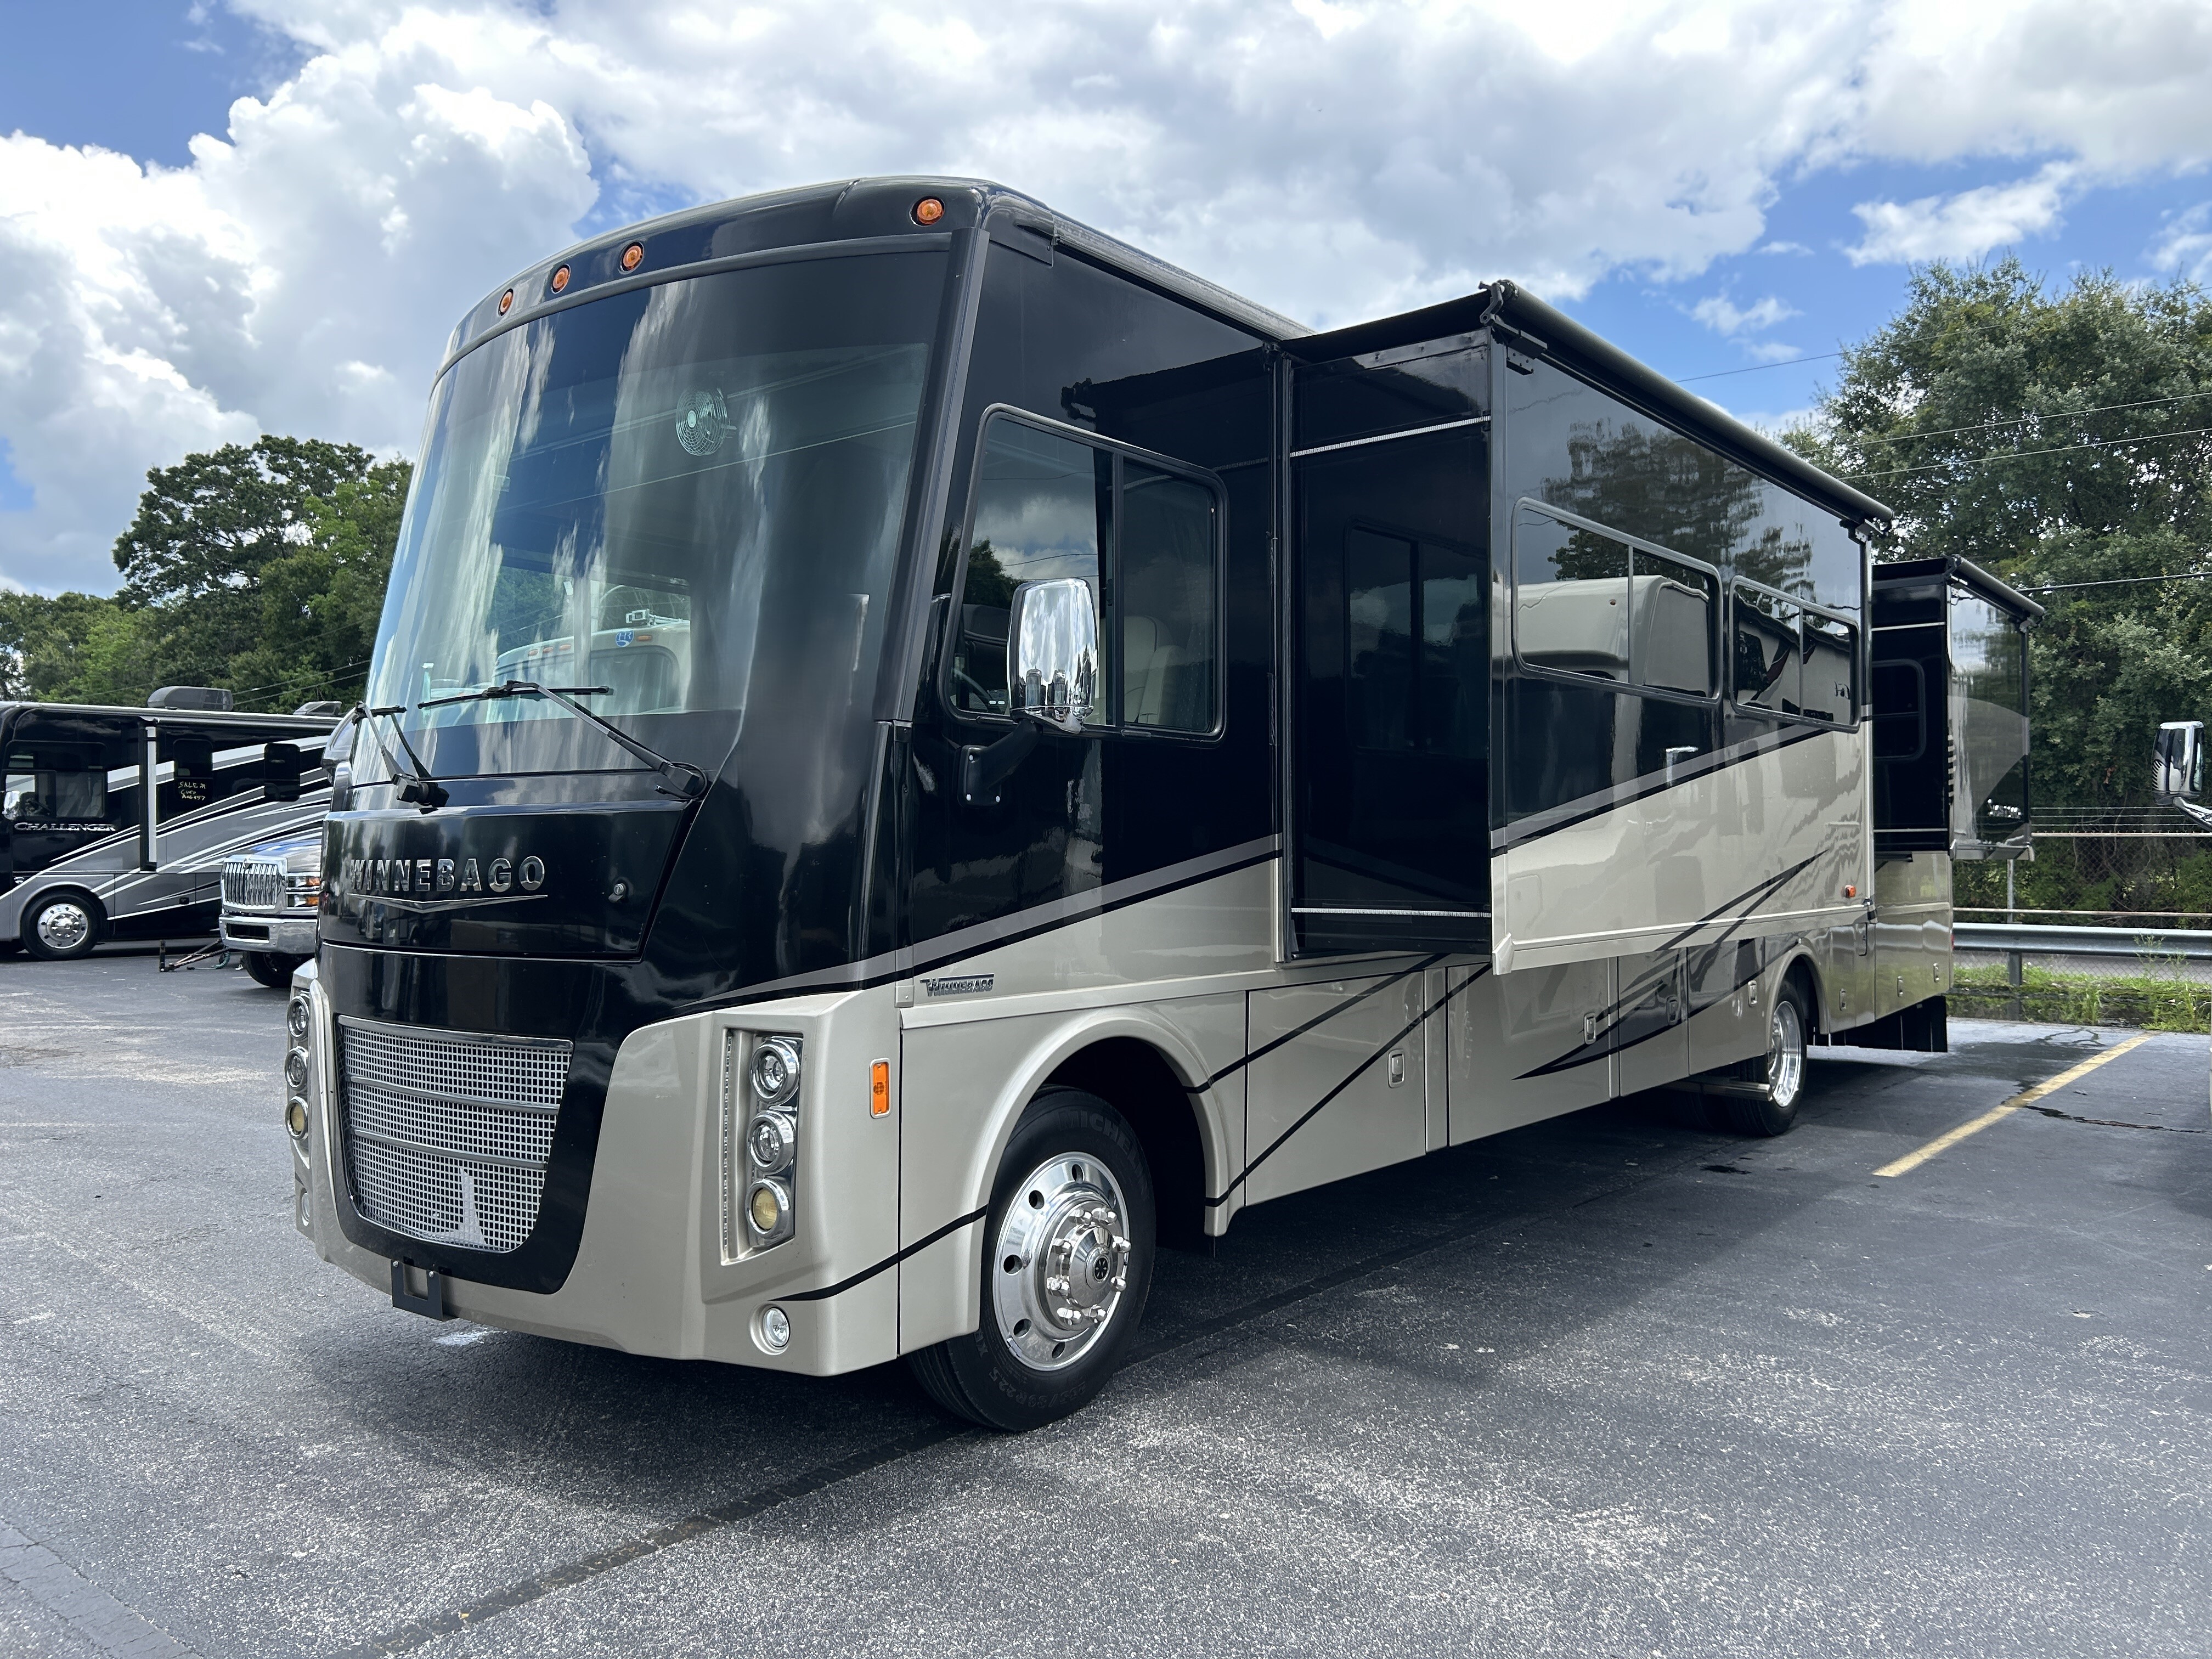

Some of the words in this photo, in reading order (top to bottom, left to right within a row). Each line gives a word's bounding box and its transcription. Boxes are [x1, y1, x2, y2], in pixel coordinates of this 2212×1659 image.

[14, 822, 116, 831] CHALLENGER
[350, 856, 545, 893] WINNEBAGO
[1058, 1108, 1149, 1201] MICHELIN
